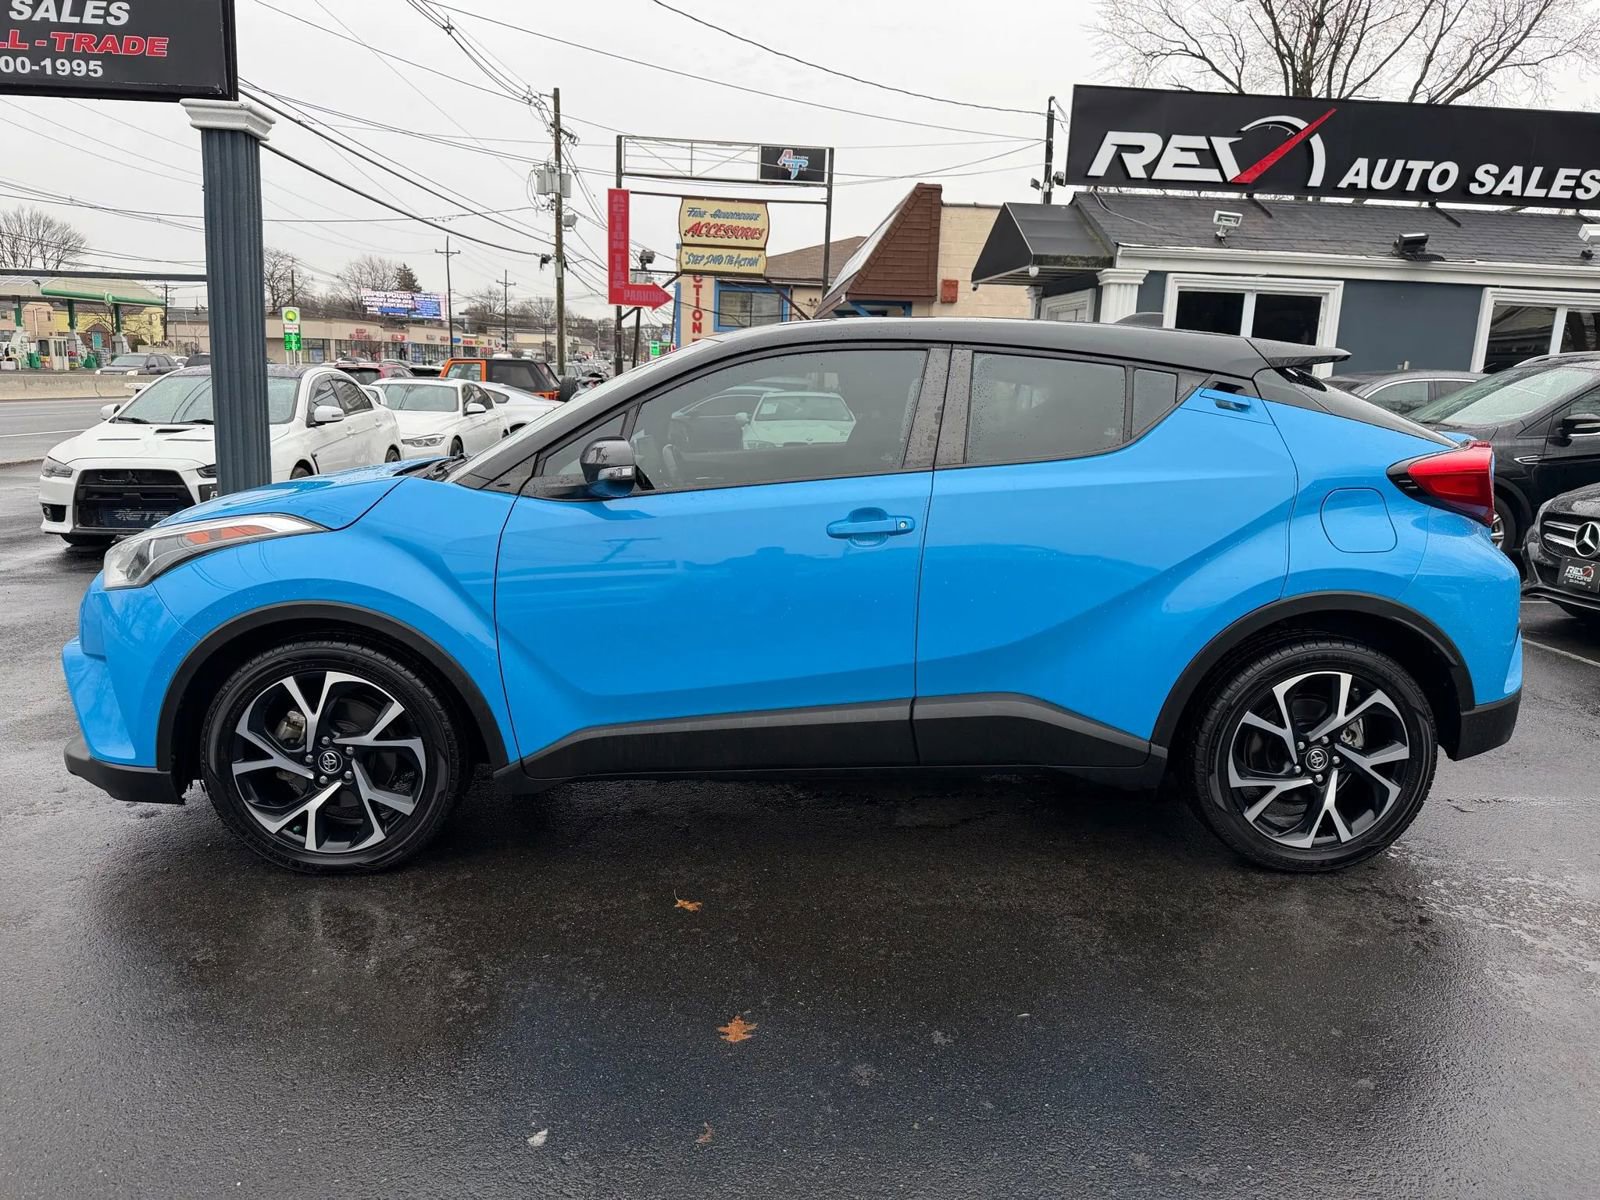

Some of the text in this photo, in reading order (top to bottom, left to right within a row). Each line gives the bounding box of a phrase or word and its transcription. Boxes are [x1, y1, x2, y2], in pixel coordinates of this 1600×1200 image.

[8, 0, 130, 25] SALES
[51, 32, 169, 57] TRADE
[1337, 157, 1459, 193] AUTO
[1469, 163, 1600, 201] SALES
[684, 221, 765, 240] ACCESSORIES
